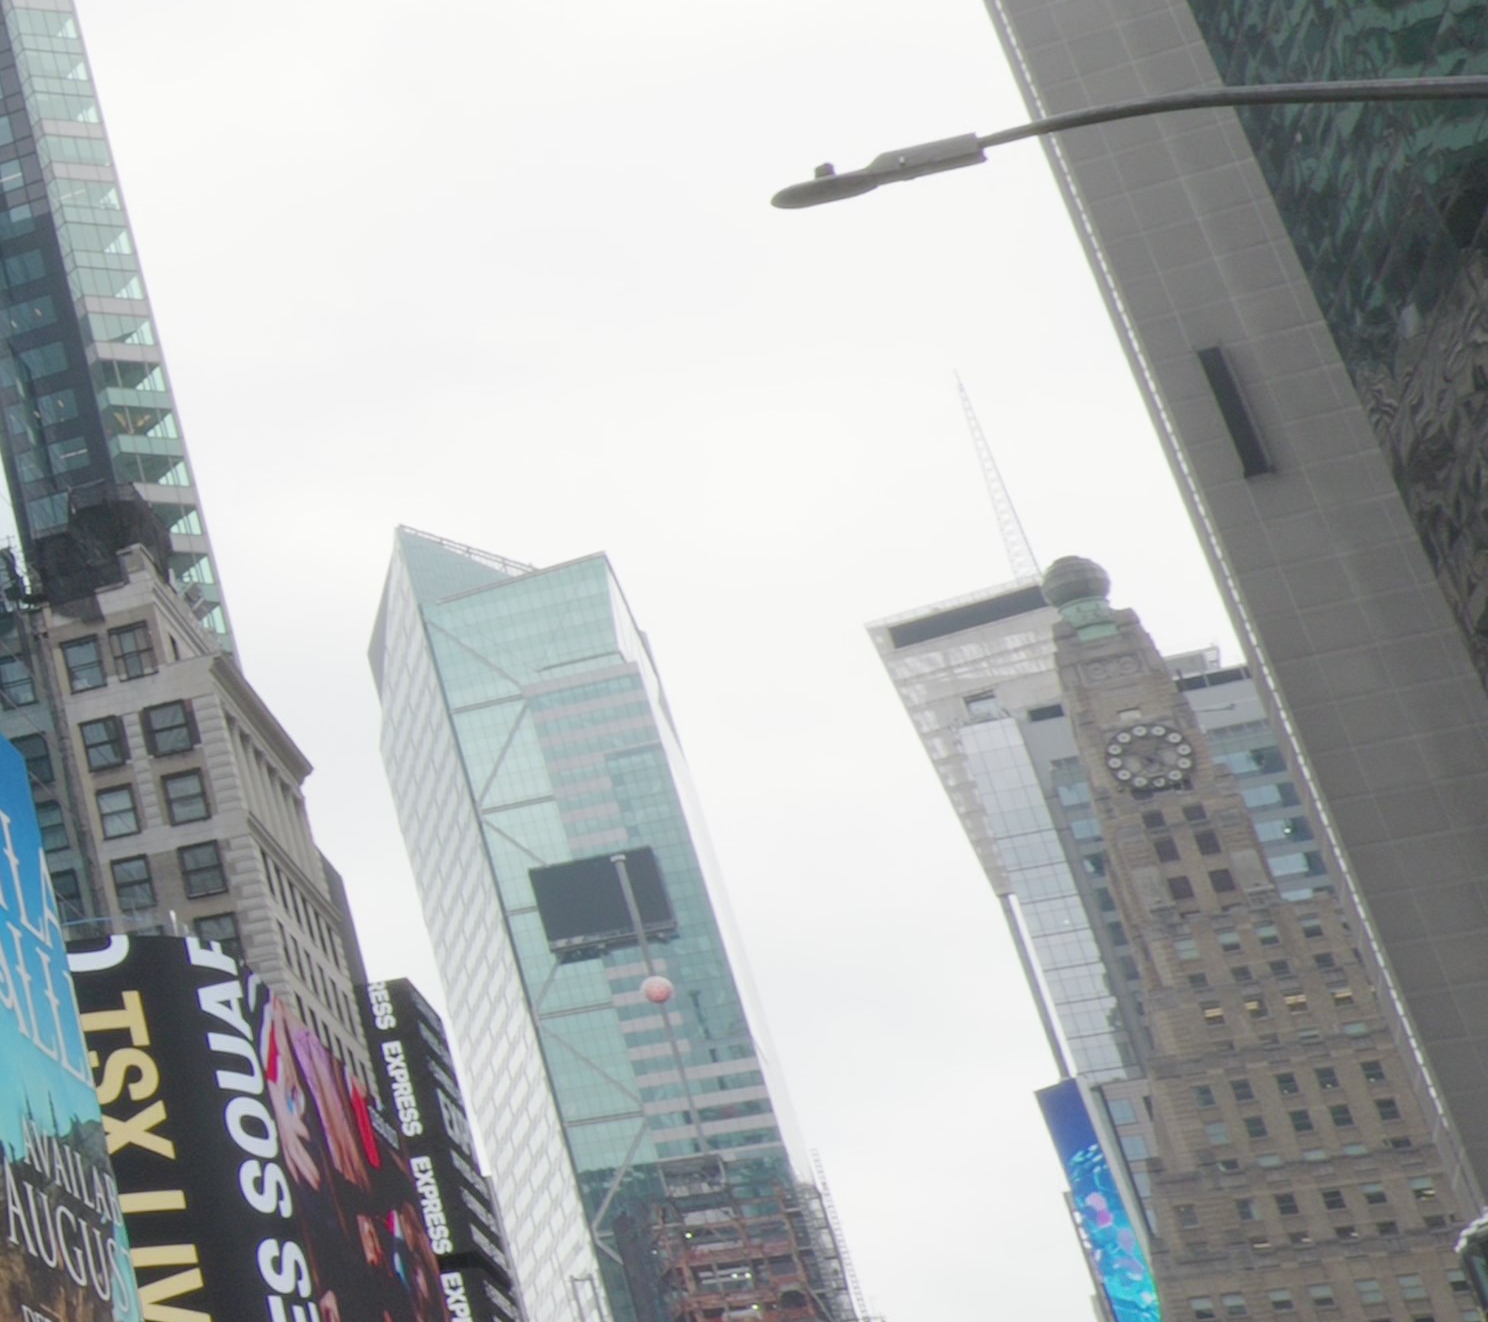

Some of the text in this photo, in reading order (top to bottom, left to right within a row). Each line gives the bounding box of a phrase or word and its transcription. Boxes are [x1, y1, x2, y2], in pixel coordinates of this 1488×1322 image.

[184, 935, 294, 1220] SQUA
[379, 1039, 425, 1138] EXPRESS
[22, 1115, 124, 1228] AVAILAB
[409, 1154, 454, 1256] EXPRESS
